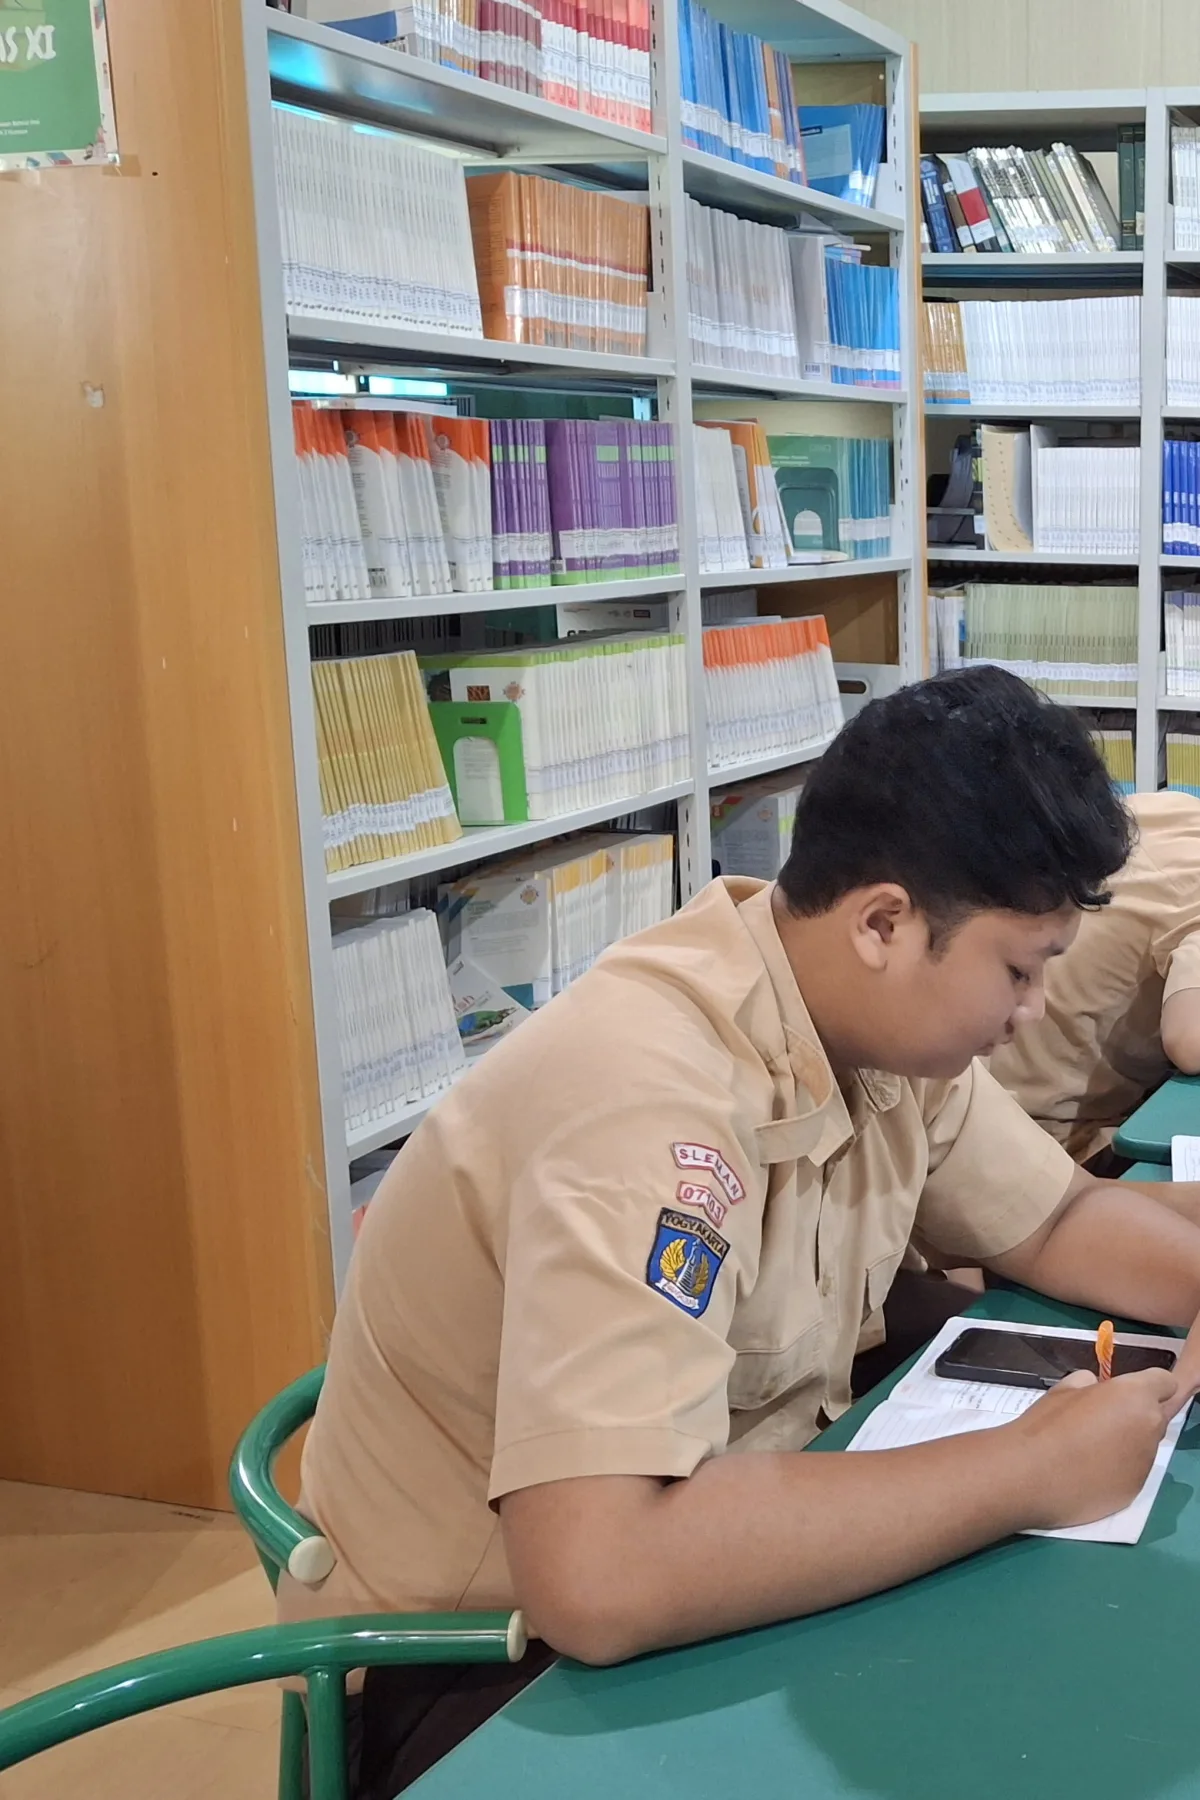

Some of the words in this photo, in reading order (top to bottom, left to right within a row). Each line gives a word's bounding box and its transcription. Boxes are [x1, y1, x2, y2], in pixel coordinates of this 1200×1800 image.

[25, 25, 57, 61] XI
[679, 1148, 739, 1196] SLEMAN
[683, 1186, 722, 1219] 07103
[664, 1213, 726, 1254] YOGYAKARTA
